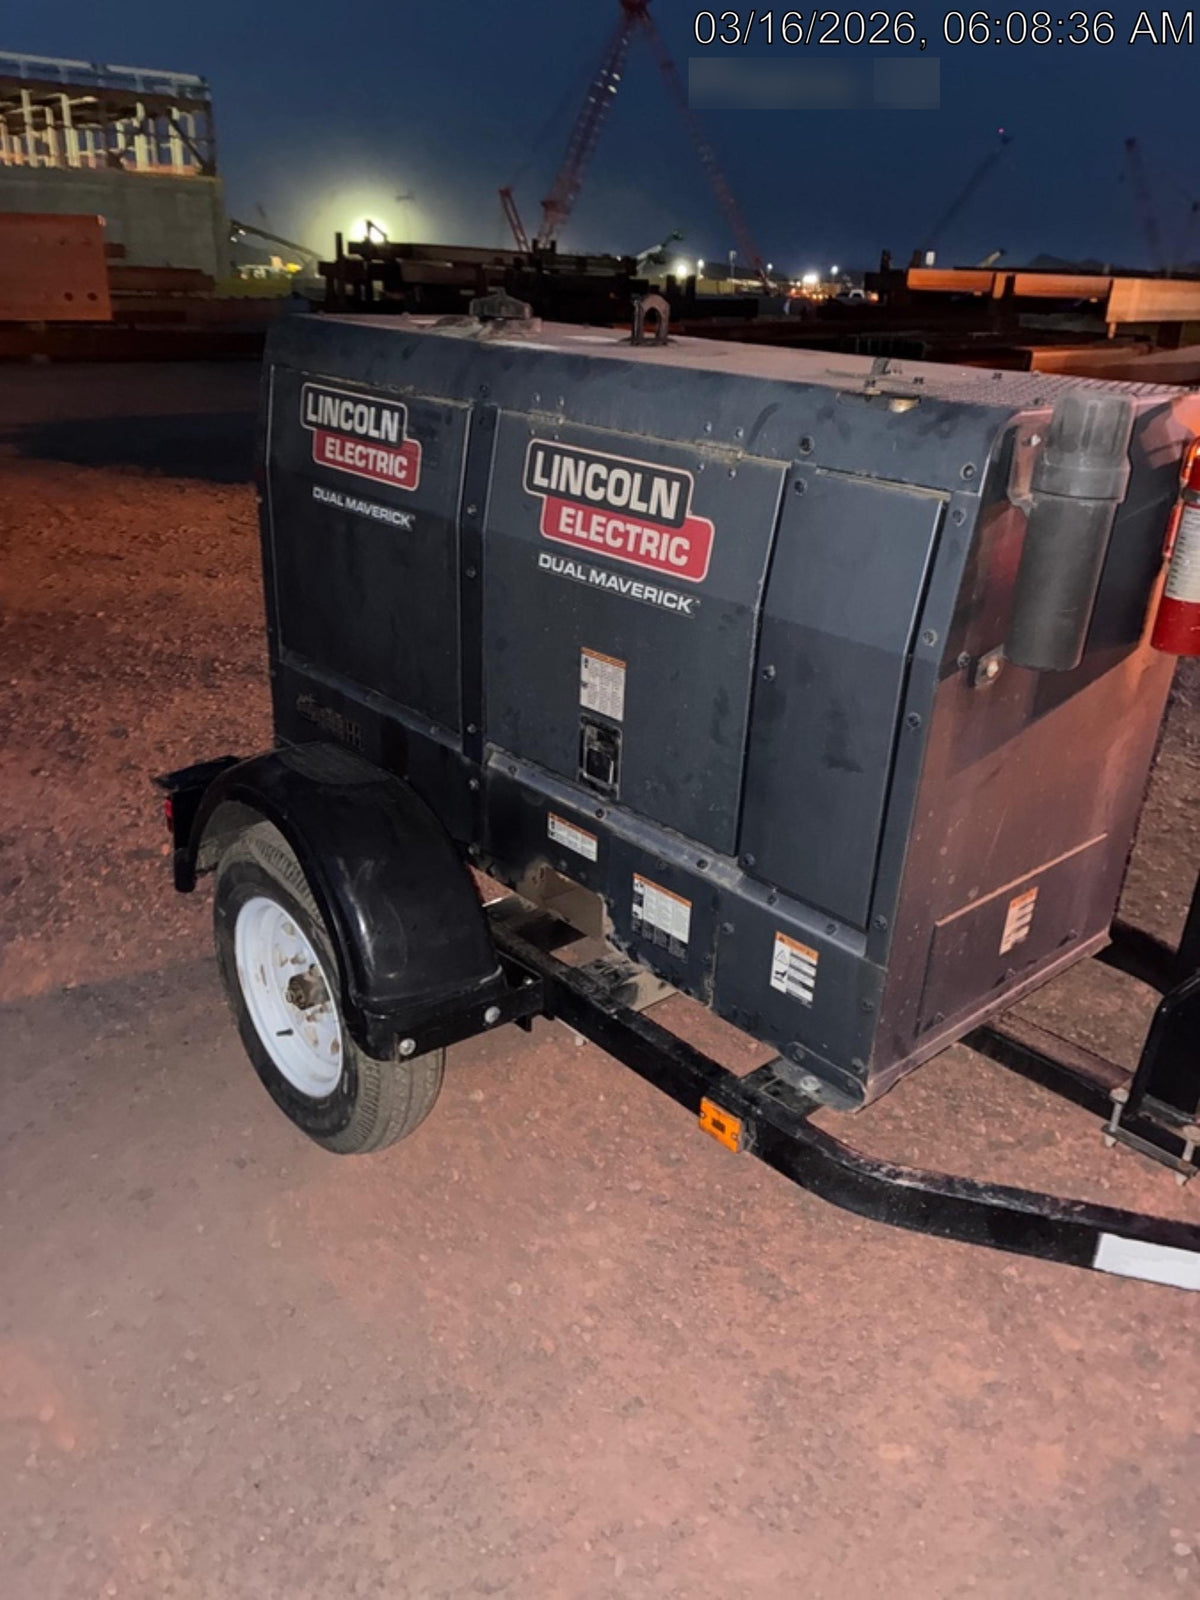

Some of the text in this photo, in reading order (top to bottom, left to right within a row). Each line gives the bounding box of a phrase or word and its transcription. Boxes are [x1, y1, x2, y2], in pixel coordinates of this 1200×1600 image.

[306, 392, 400, 443] LINCOLN
[324, 436, 409, 479] ELECTRIC
[533, 450, 681, 520] LINCOLN
[312, 486, 412, 530] DUAL MAVERICK
[559, 506, 691, 567] ELECTRIC
[538, 553, 694, 614] DUAL MAVERICK
